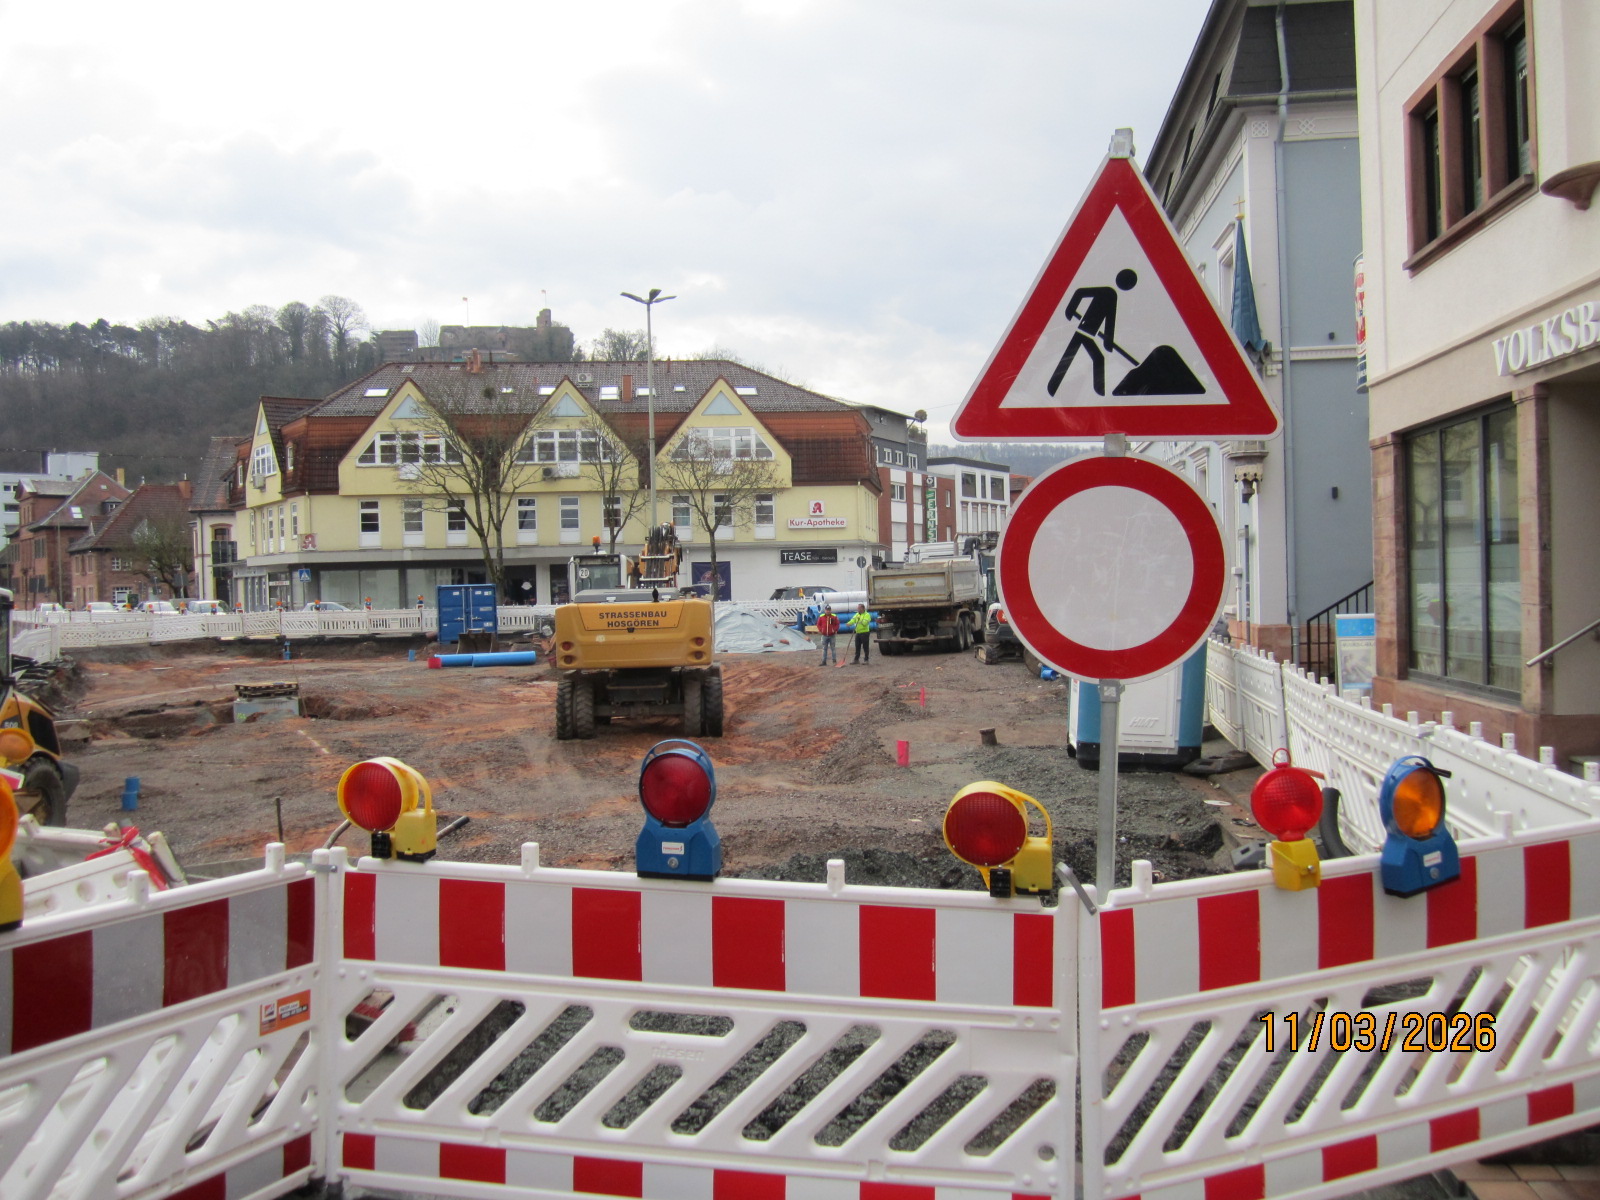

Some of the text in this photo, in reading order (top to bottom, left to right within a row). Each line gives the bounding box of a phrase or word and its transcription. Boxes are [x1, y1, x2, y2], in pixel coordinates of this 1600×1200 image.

[1491, 301, 1600, 376] VOLKSB
[789, 519, 845, 527] Kur-Apotheke
[926, 500, 936, 543] ERNS
[782, 552, 812, 561] TEASE
[580, 569, 588, 577] 20
[598, 610, 667, 620] STRASSENBAU
[607, 618, 659, 628] HOSGÖREN
[1128, 716, 1160, 729] HMT
